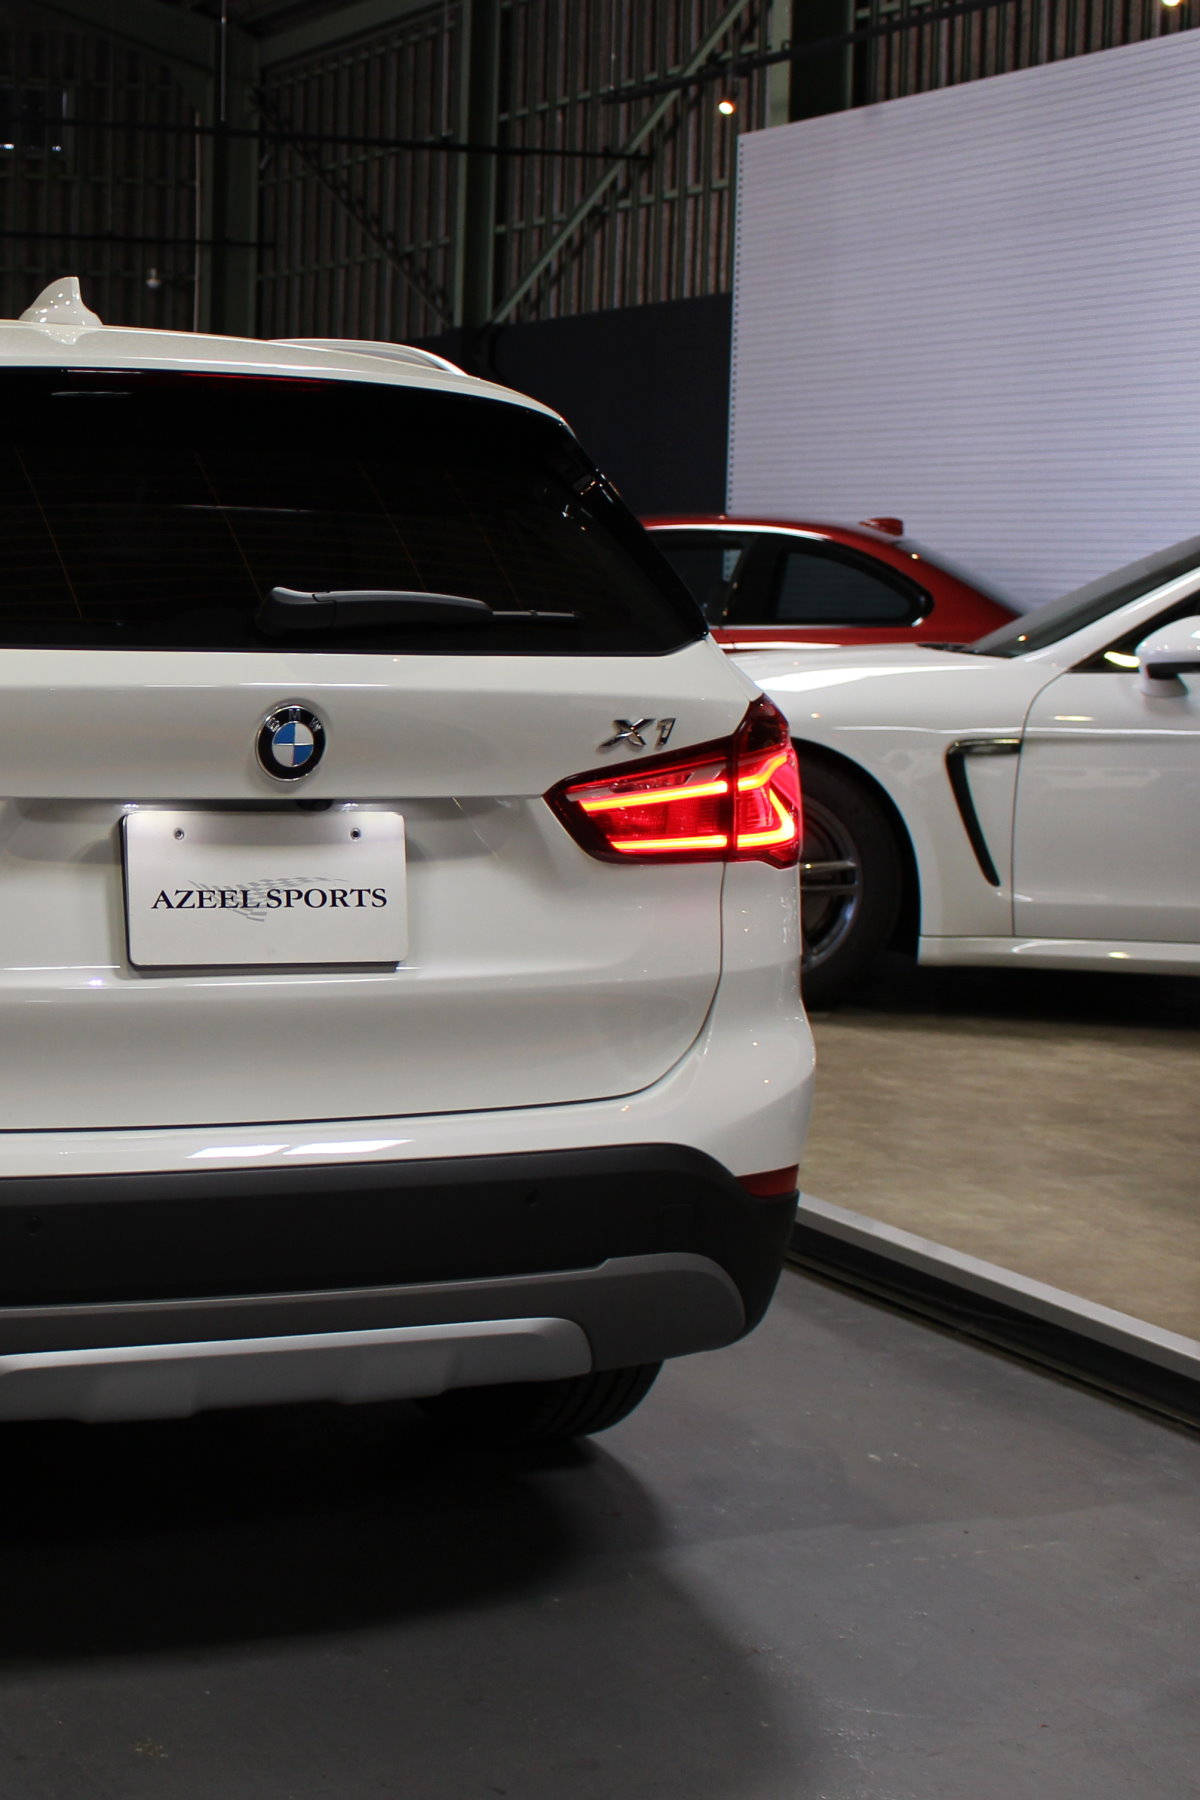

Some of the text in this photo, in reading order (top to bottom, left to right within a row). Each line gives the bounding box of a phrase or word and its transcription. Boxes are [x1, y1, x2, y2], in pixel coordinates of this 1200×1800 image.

[265, 707, 322, 733] BMW
[599, 717, 677, 747] X1
[151, 888, 388, 909] AZEEL SPORTS
